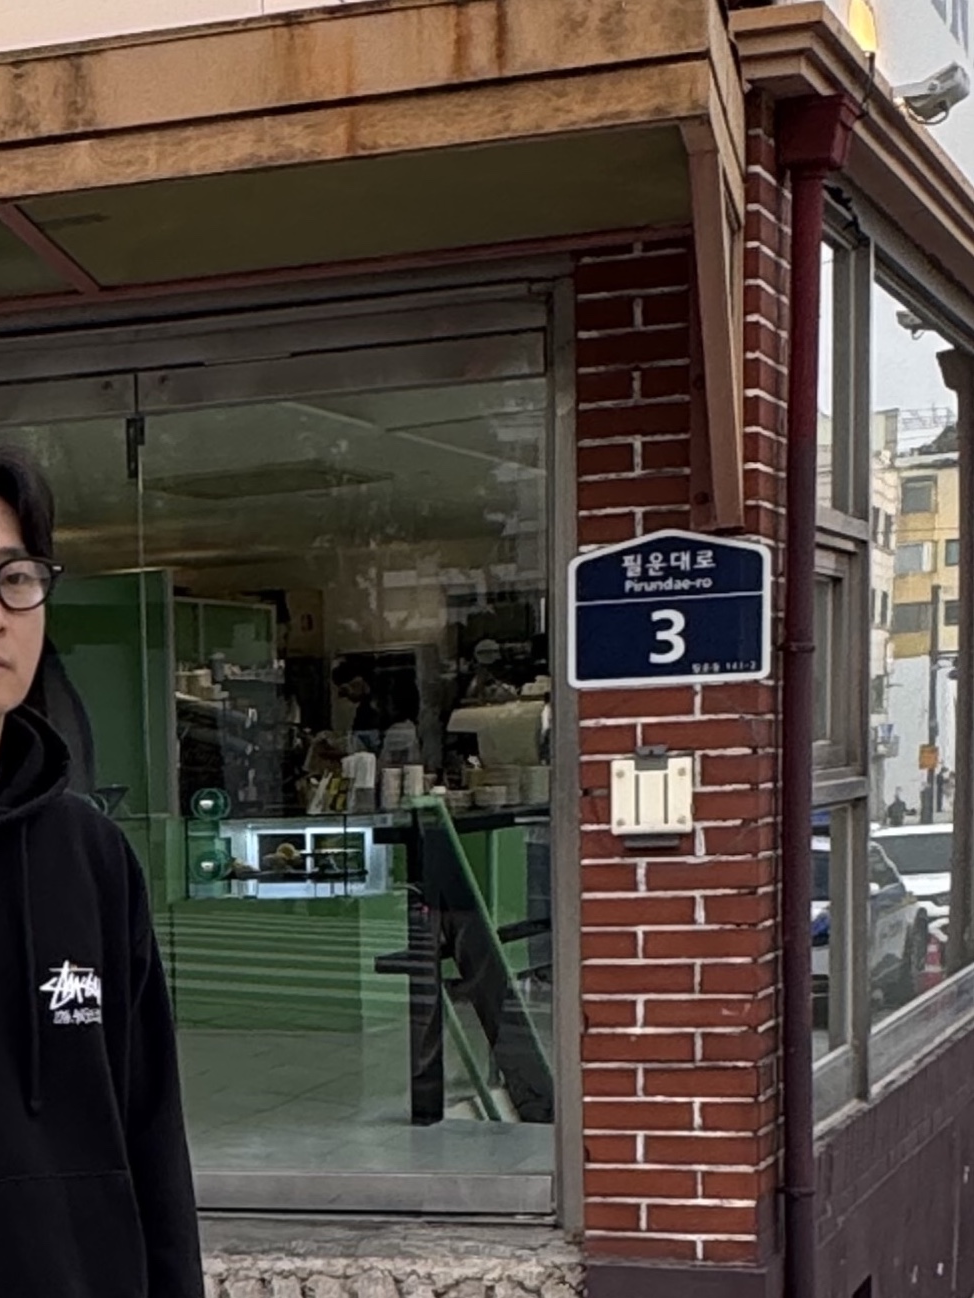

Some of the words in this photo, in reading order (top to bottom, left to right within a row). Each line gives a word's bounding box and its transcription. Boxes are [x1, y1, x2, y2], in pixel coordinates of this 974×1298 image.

[621, 550, 716, 578] 필운대로
[624, 577, 713, 593] Pirundae-ro
[649, 608, 686, 664] 3
